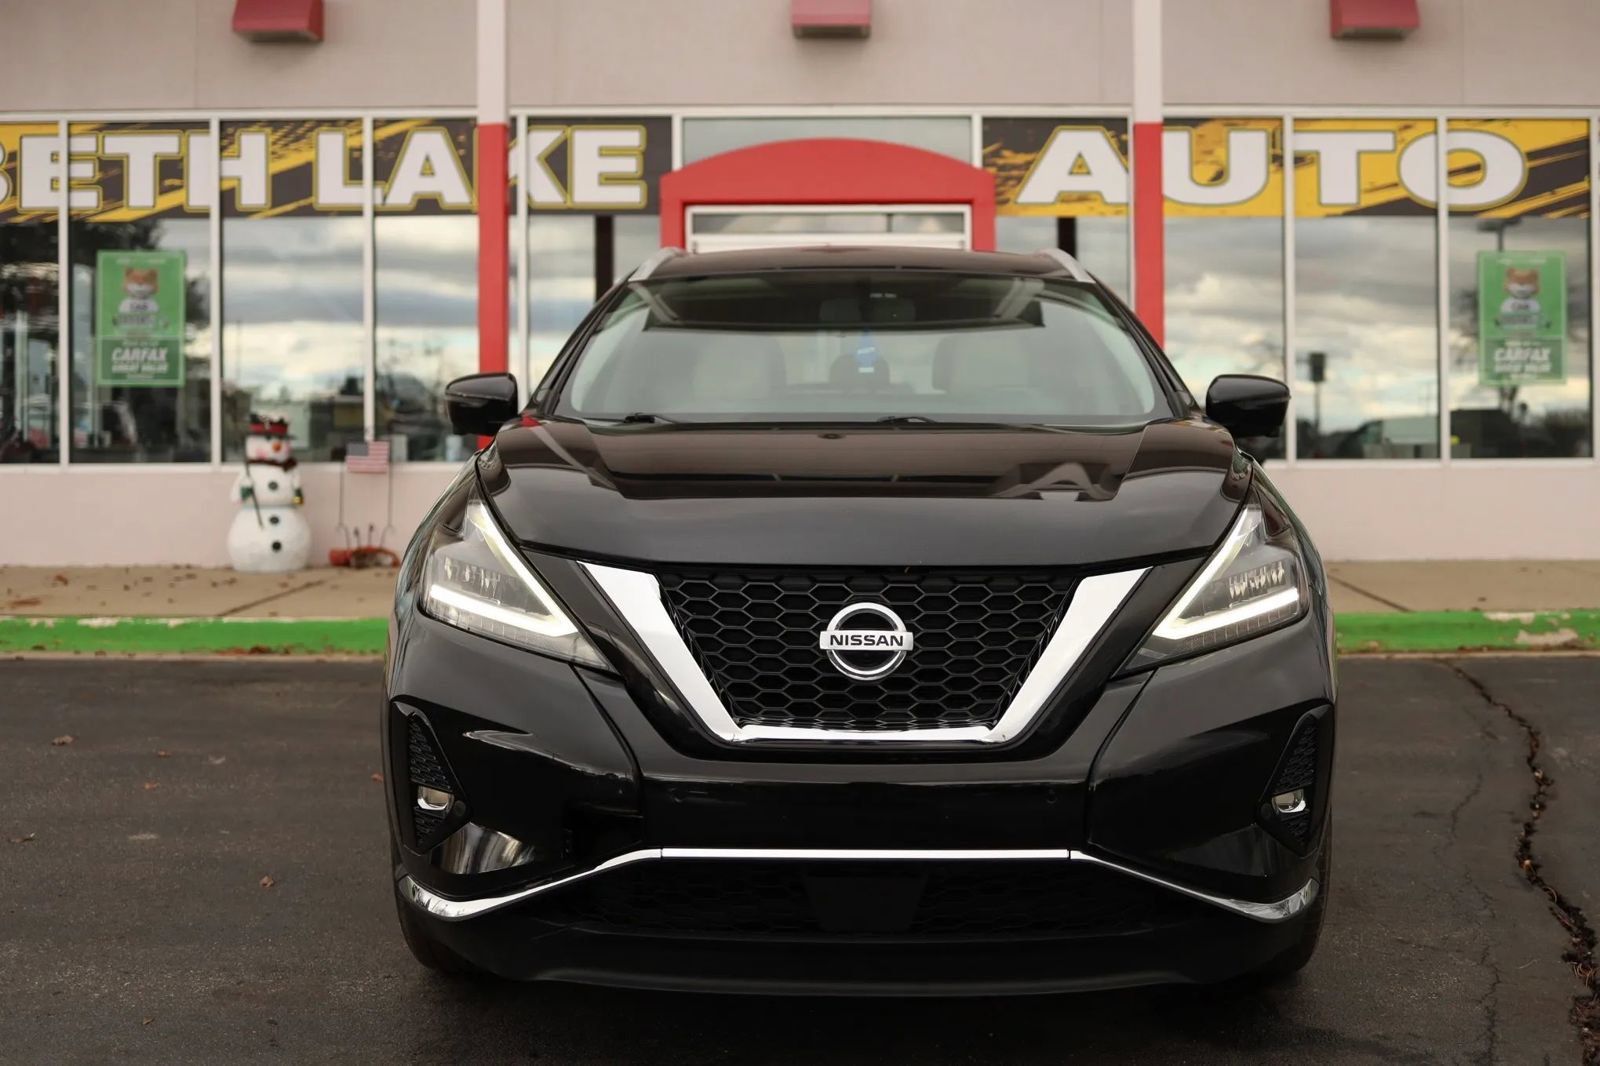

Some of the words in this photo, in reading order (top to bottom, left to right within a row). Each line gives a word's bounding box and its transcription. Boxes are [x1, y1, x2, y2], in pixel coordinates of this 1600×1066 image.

[0, 131, 271, 212] ETH
[313, 126, 647, 210] LAKE
[1014, 126, 1529, 212] AUTO
[111, 347, 168, 361] CARFAX
[830, 634, 904, 647] NISSAN
